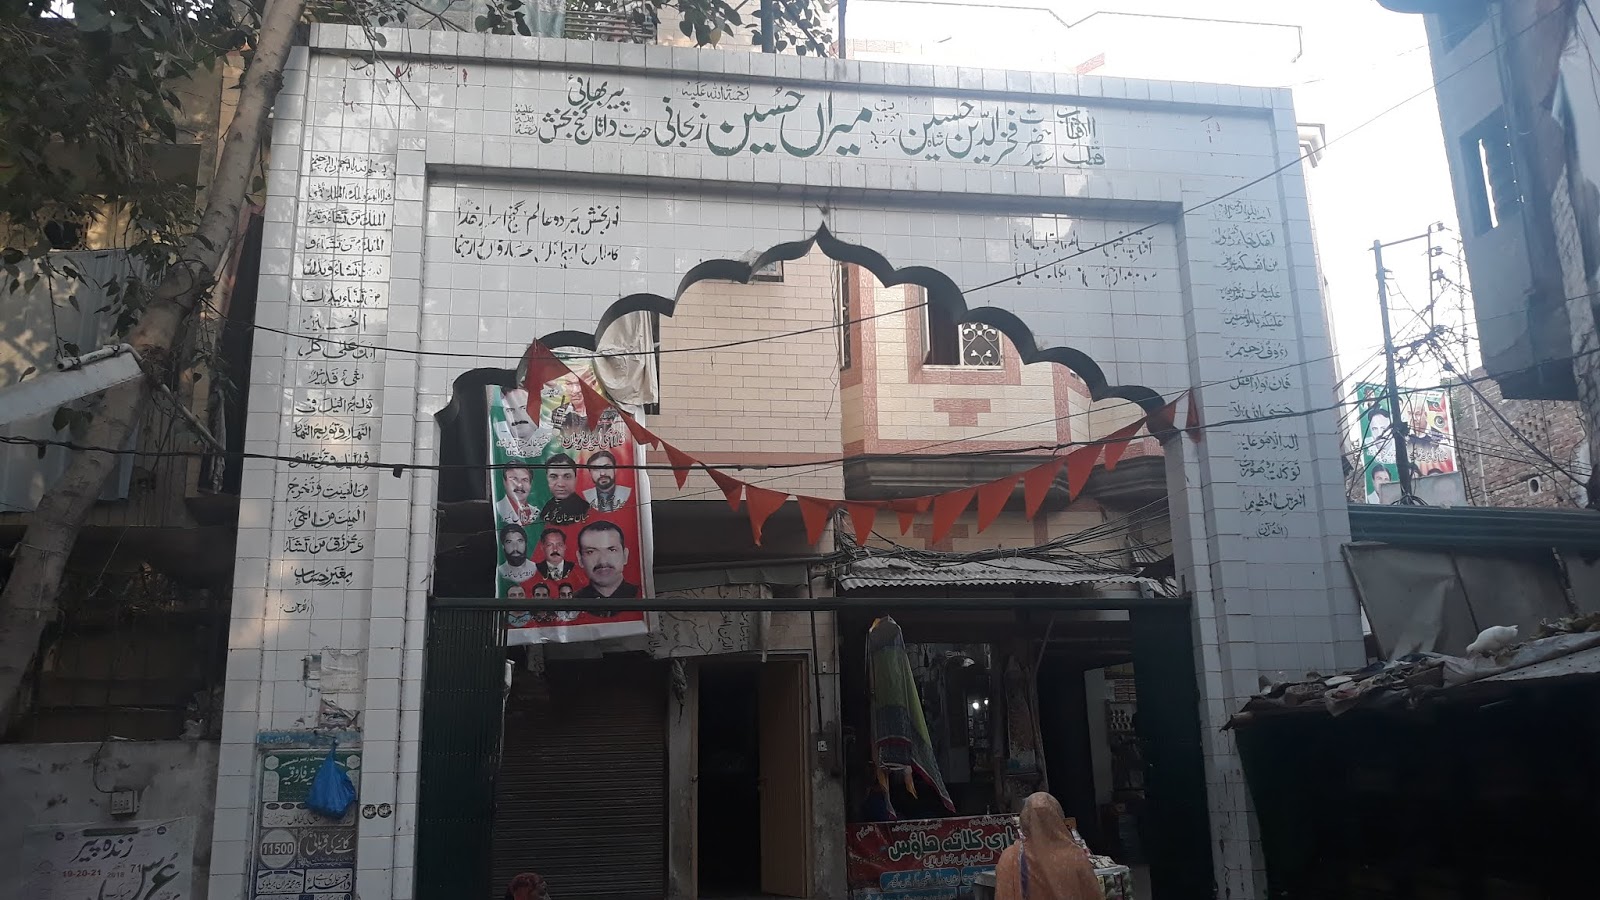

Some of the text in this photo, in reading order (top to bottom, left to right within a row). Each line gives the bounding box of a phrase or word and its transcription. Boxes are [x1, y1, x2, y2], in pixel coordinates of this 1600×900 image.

[606, 86, 631, 113] پیر
[538, 101, 652, 147] حضرت داتا گنج بخش
[69, 837, 136, 863] زندہ پیر
[263, 843, 294, 855] 11500
